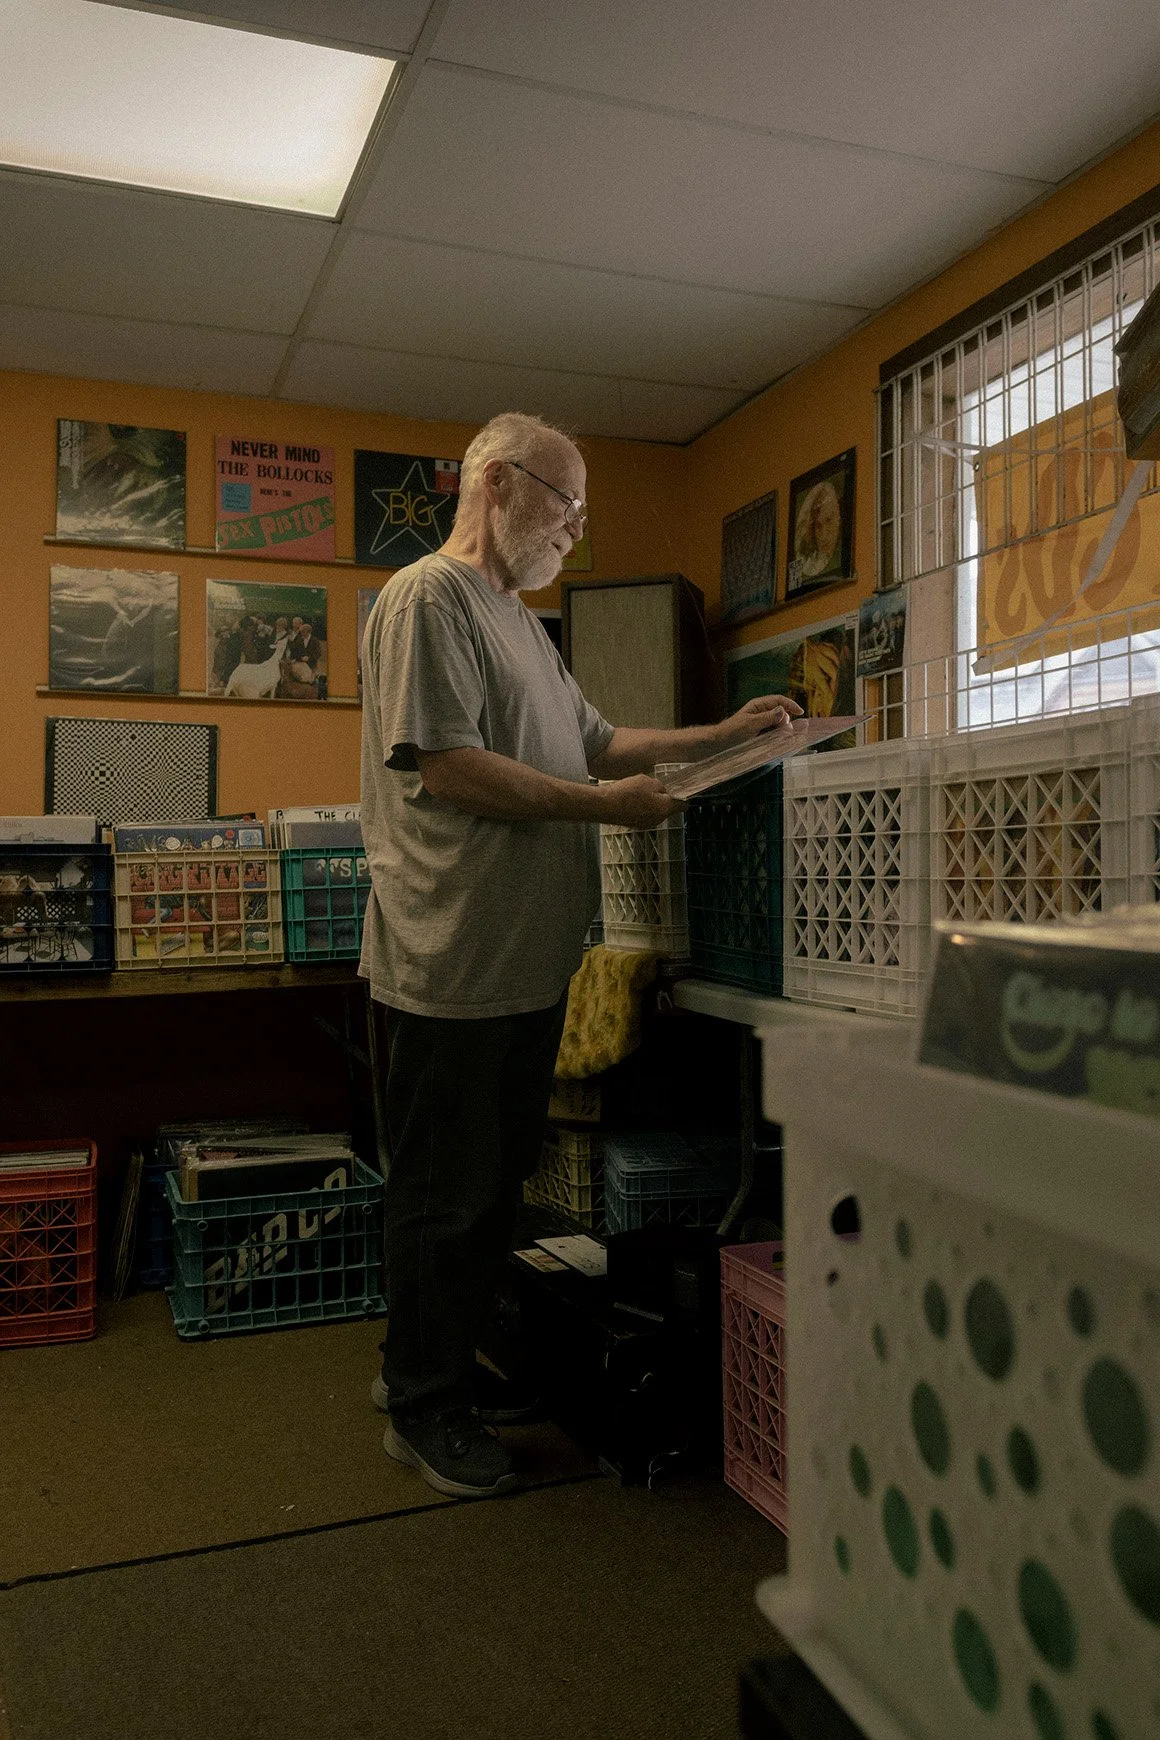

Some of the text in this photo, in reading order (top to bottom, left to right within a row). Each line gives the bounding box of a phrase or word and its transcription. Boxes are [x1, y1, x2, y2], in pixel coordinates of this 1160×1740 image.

[231, 440, 320, 463] NEVER MIND
[217, 460, 333, 484] THE BOLLOCKS
[389, 491, 434, 526] BIG
[314, 811, 336, 820] THE
